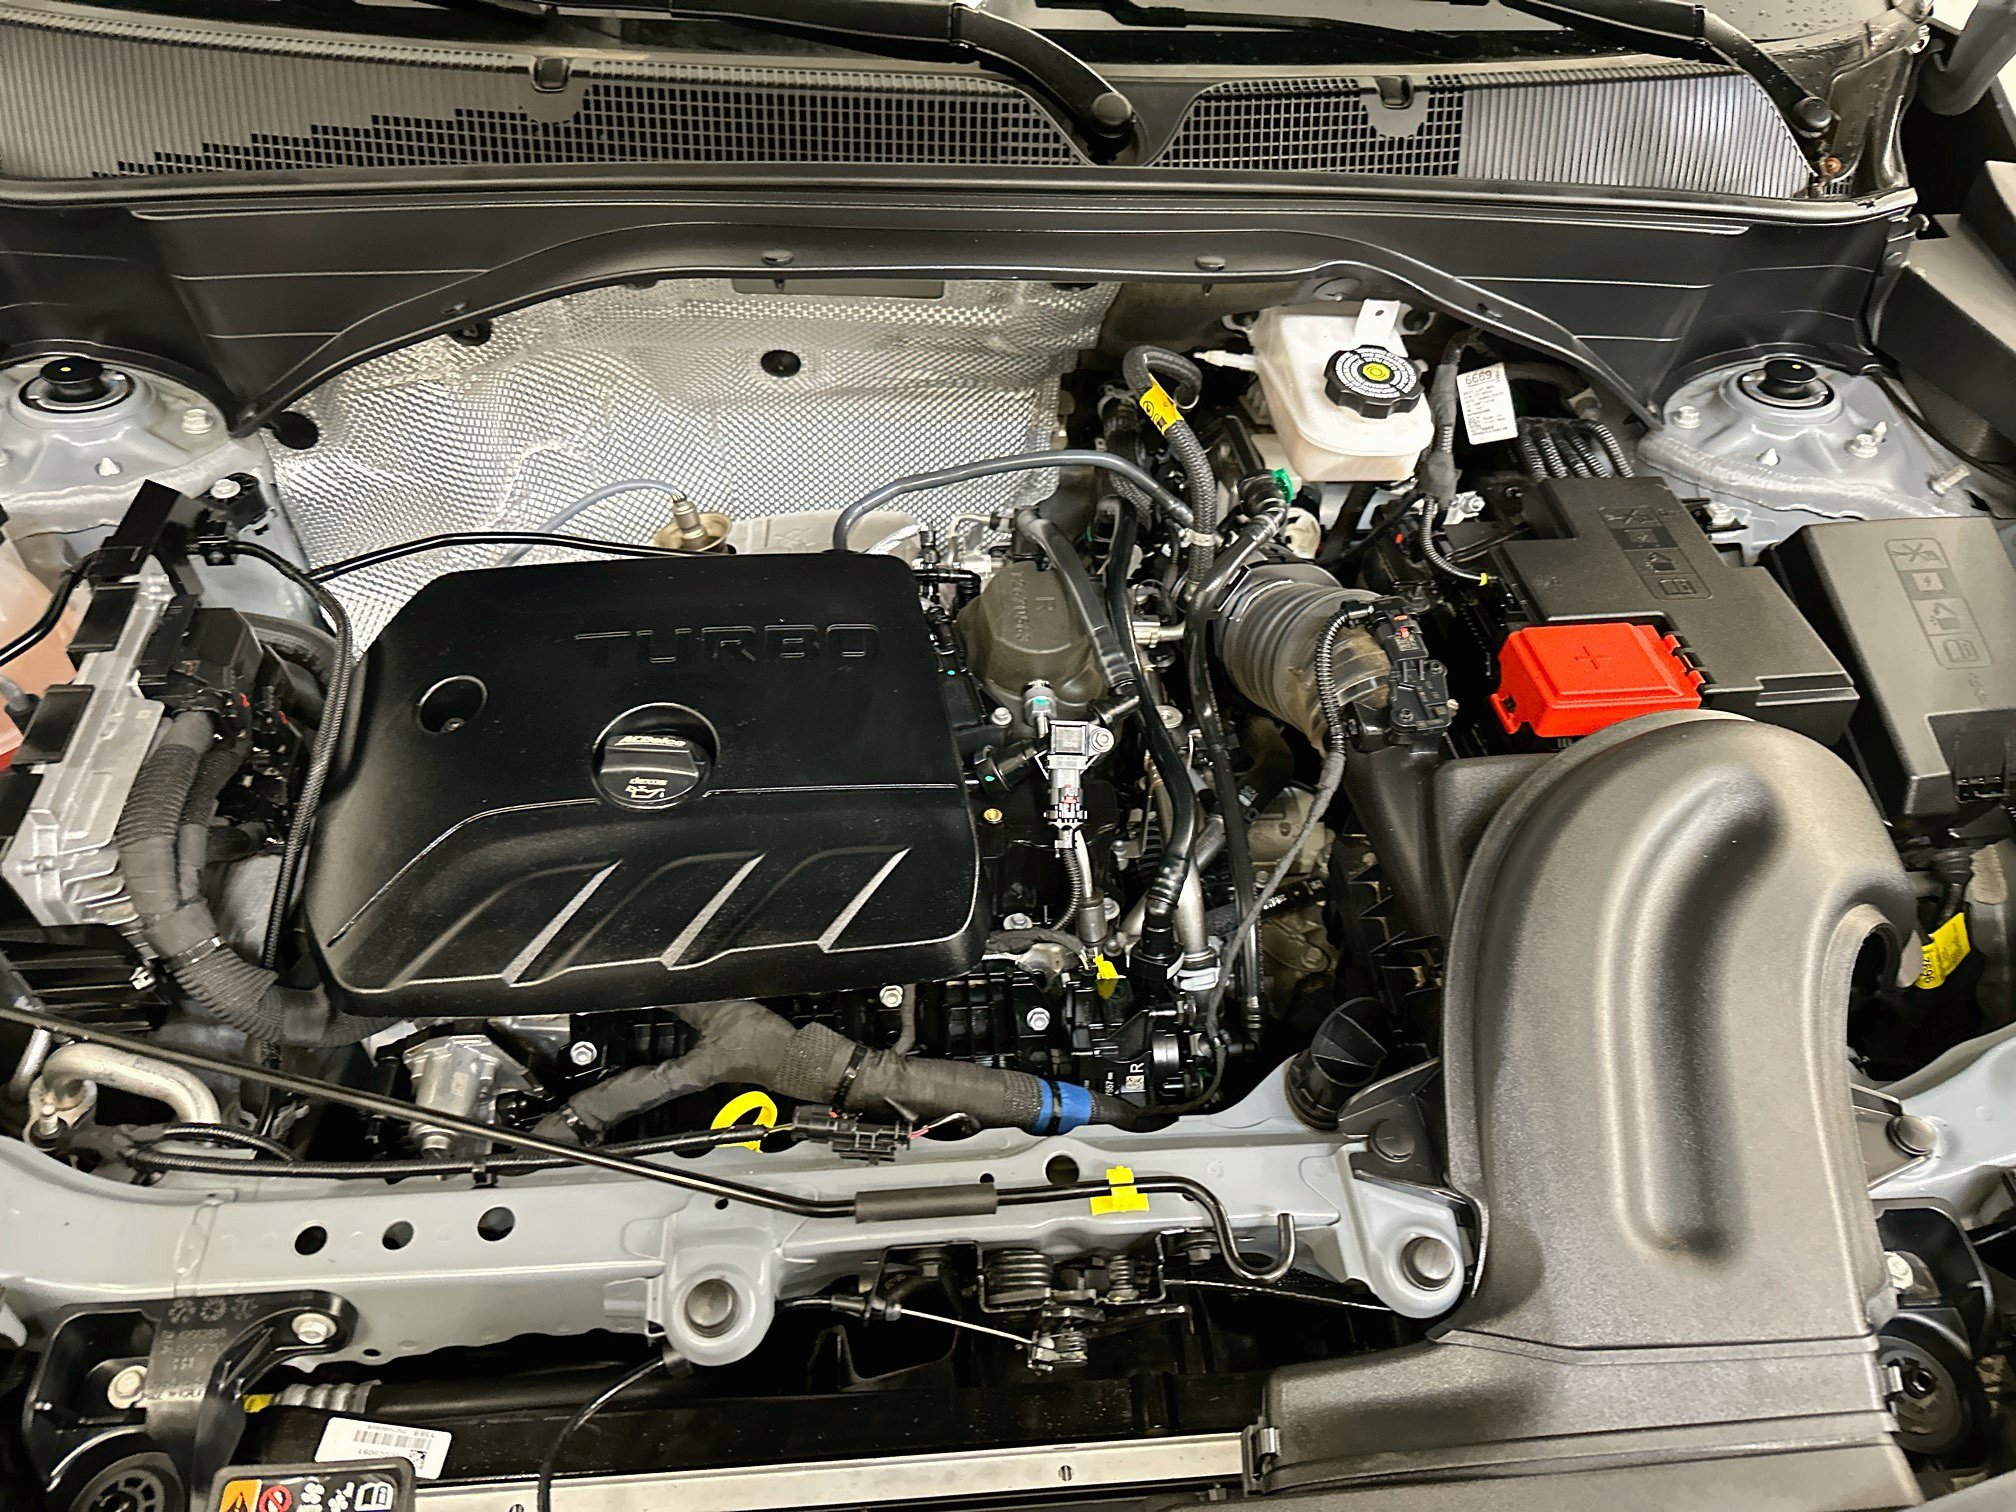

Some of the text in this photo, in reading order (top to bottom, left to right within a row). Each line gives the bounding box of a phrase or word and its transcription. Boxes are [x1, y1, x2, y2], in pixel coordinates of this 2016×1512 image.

[1465, 370, 1492, 385] 6669
[574, 622, 880, 668] TURBO
[614, 735, 686, 747] ACDelco
[1129, 1062, 1145, 1073] R
